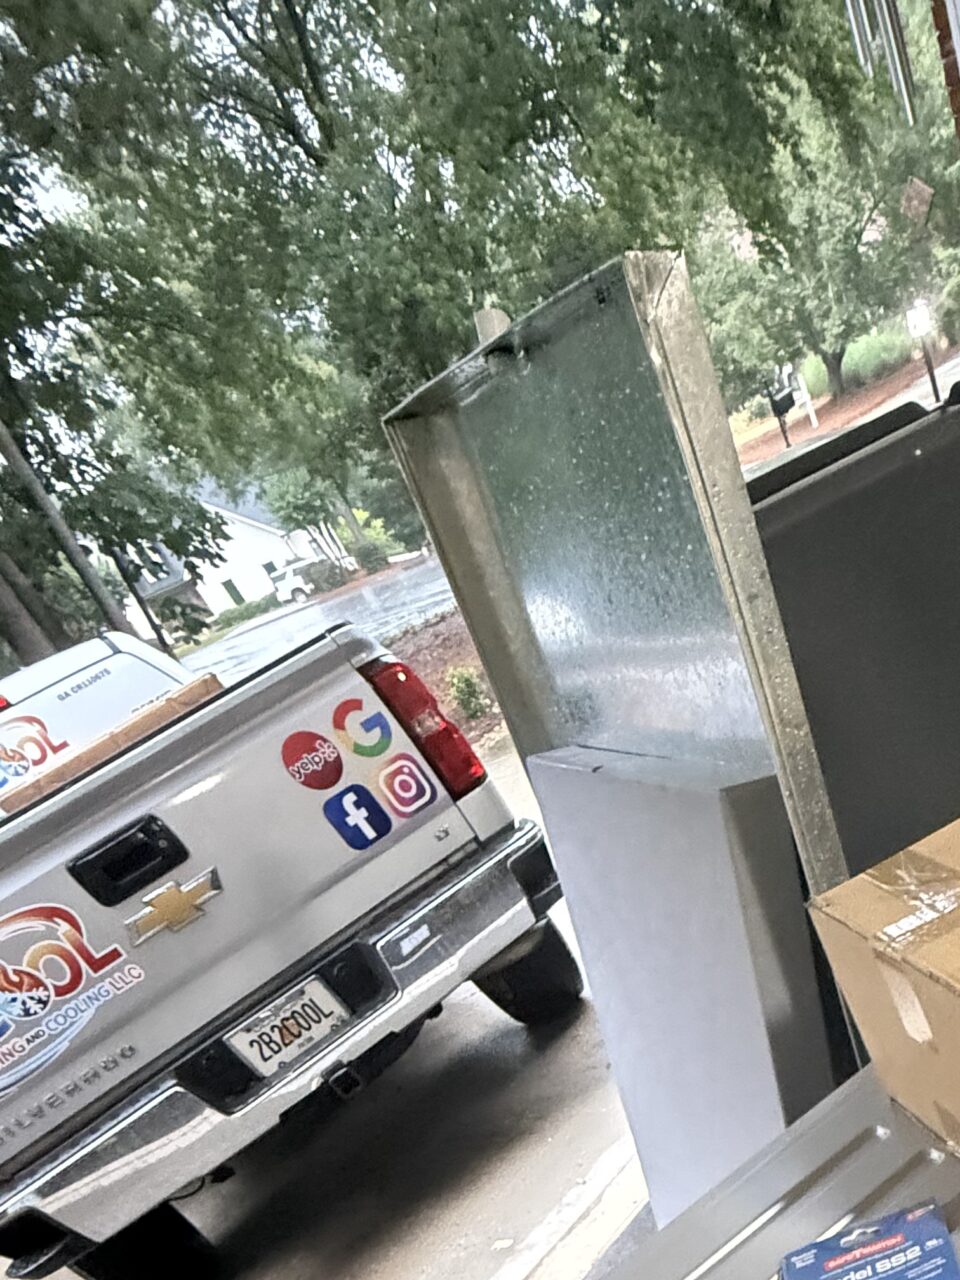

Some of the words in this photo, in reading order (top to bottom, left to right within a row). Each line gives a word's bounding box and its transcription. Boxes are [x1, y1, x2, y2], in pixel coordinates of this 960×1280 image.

[290, 751, 323, 780] yelp
[0, 1040, 26, 1066] ING
[25, 1029, 46, 1046] AND
[45, 984, 111, 1033] COOLING
[109, 965, 144, 993] LLC
[249, 998, 334, 1063] 2B2COOL
[875, 1246, 922, 1273] SS2
